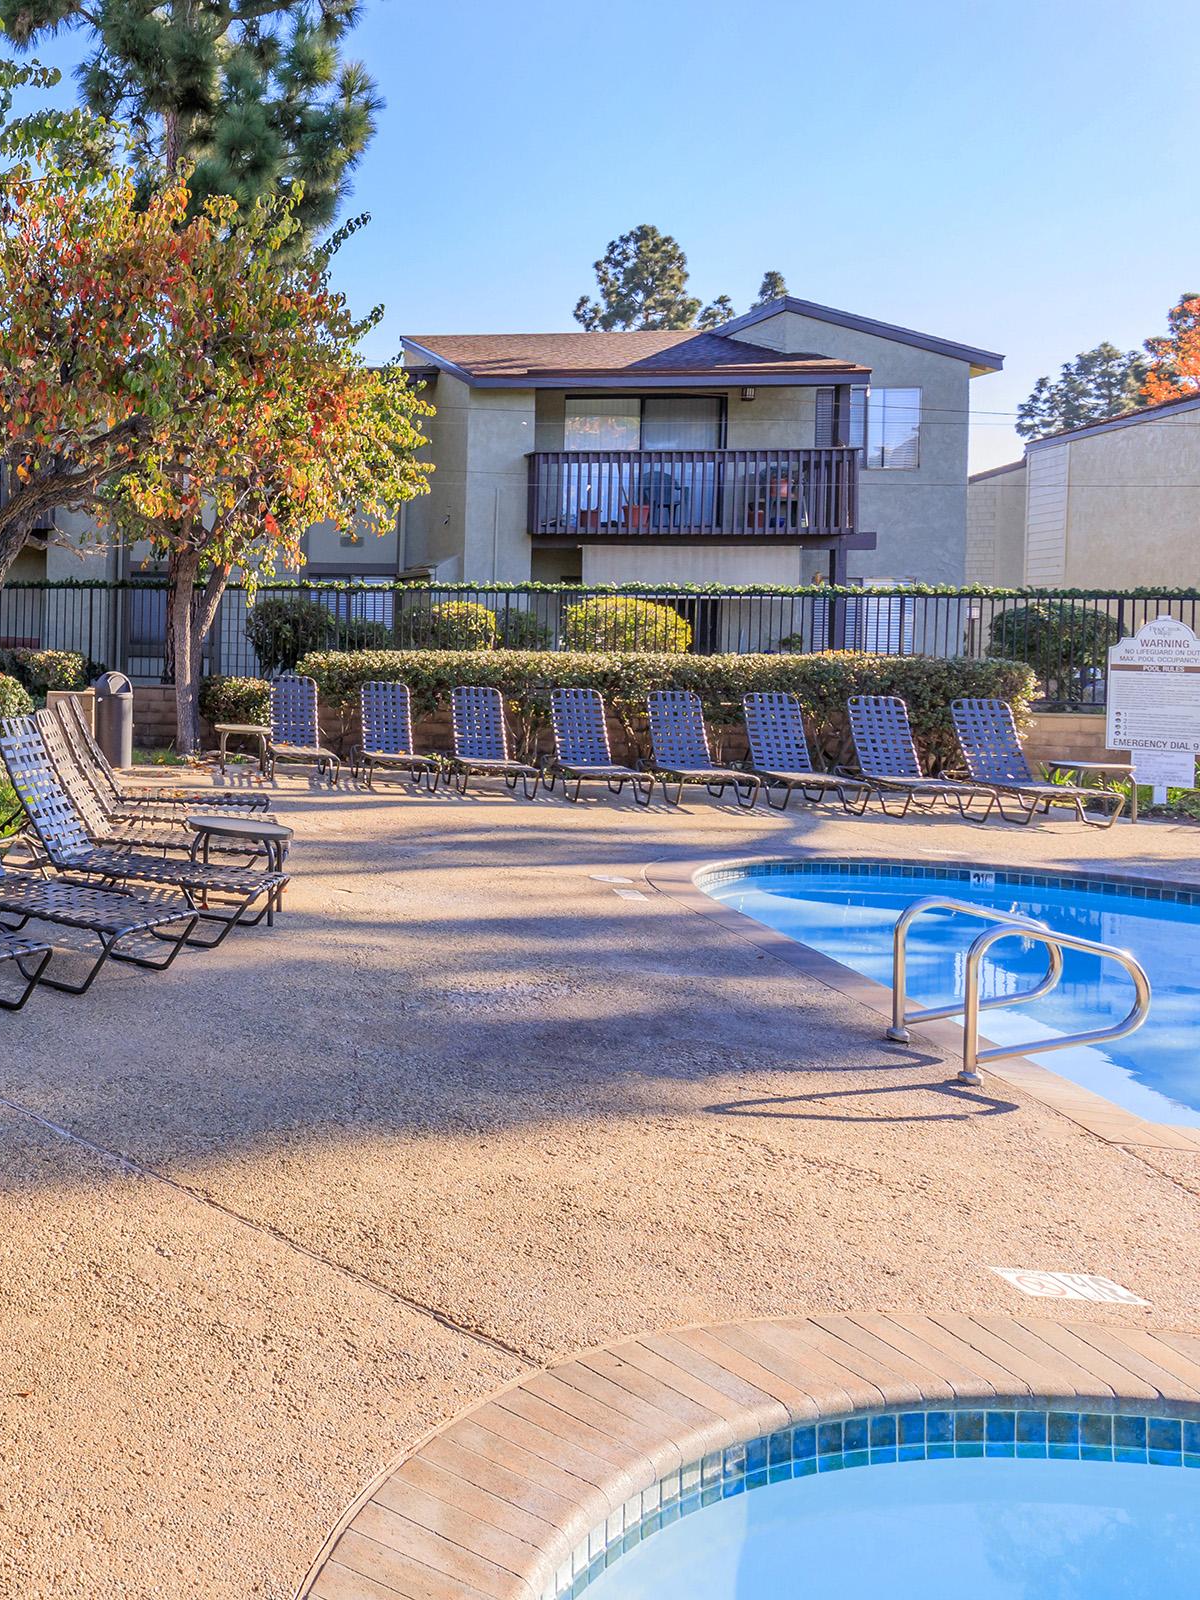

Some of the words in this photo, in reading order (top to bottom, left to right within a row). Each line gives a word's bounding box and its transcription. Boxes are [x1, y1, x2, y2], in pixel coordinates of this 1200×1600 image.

[1140, 639, 1190, 649] WARNING
[1136, 648, 1174, 656] LIFEGUARD
[1113, 738, 1168, 749] EMERGENCY
[1170, 741, 1191, 751] DIAL
[1193, 743, 1200, 751] 9
